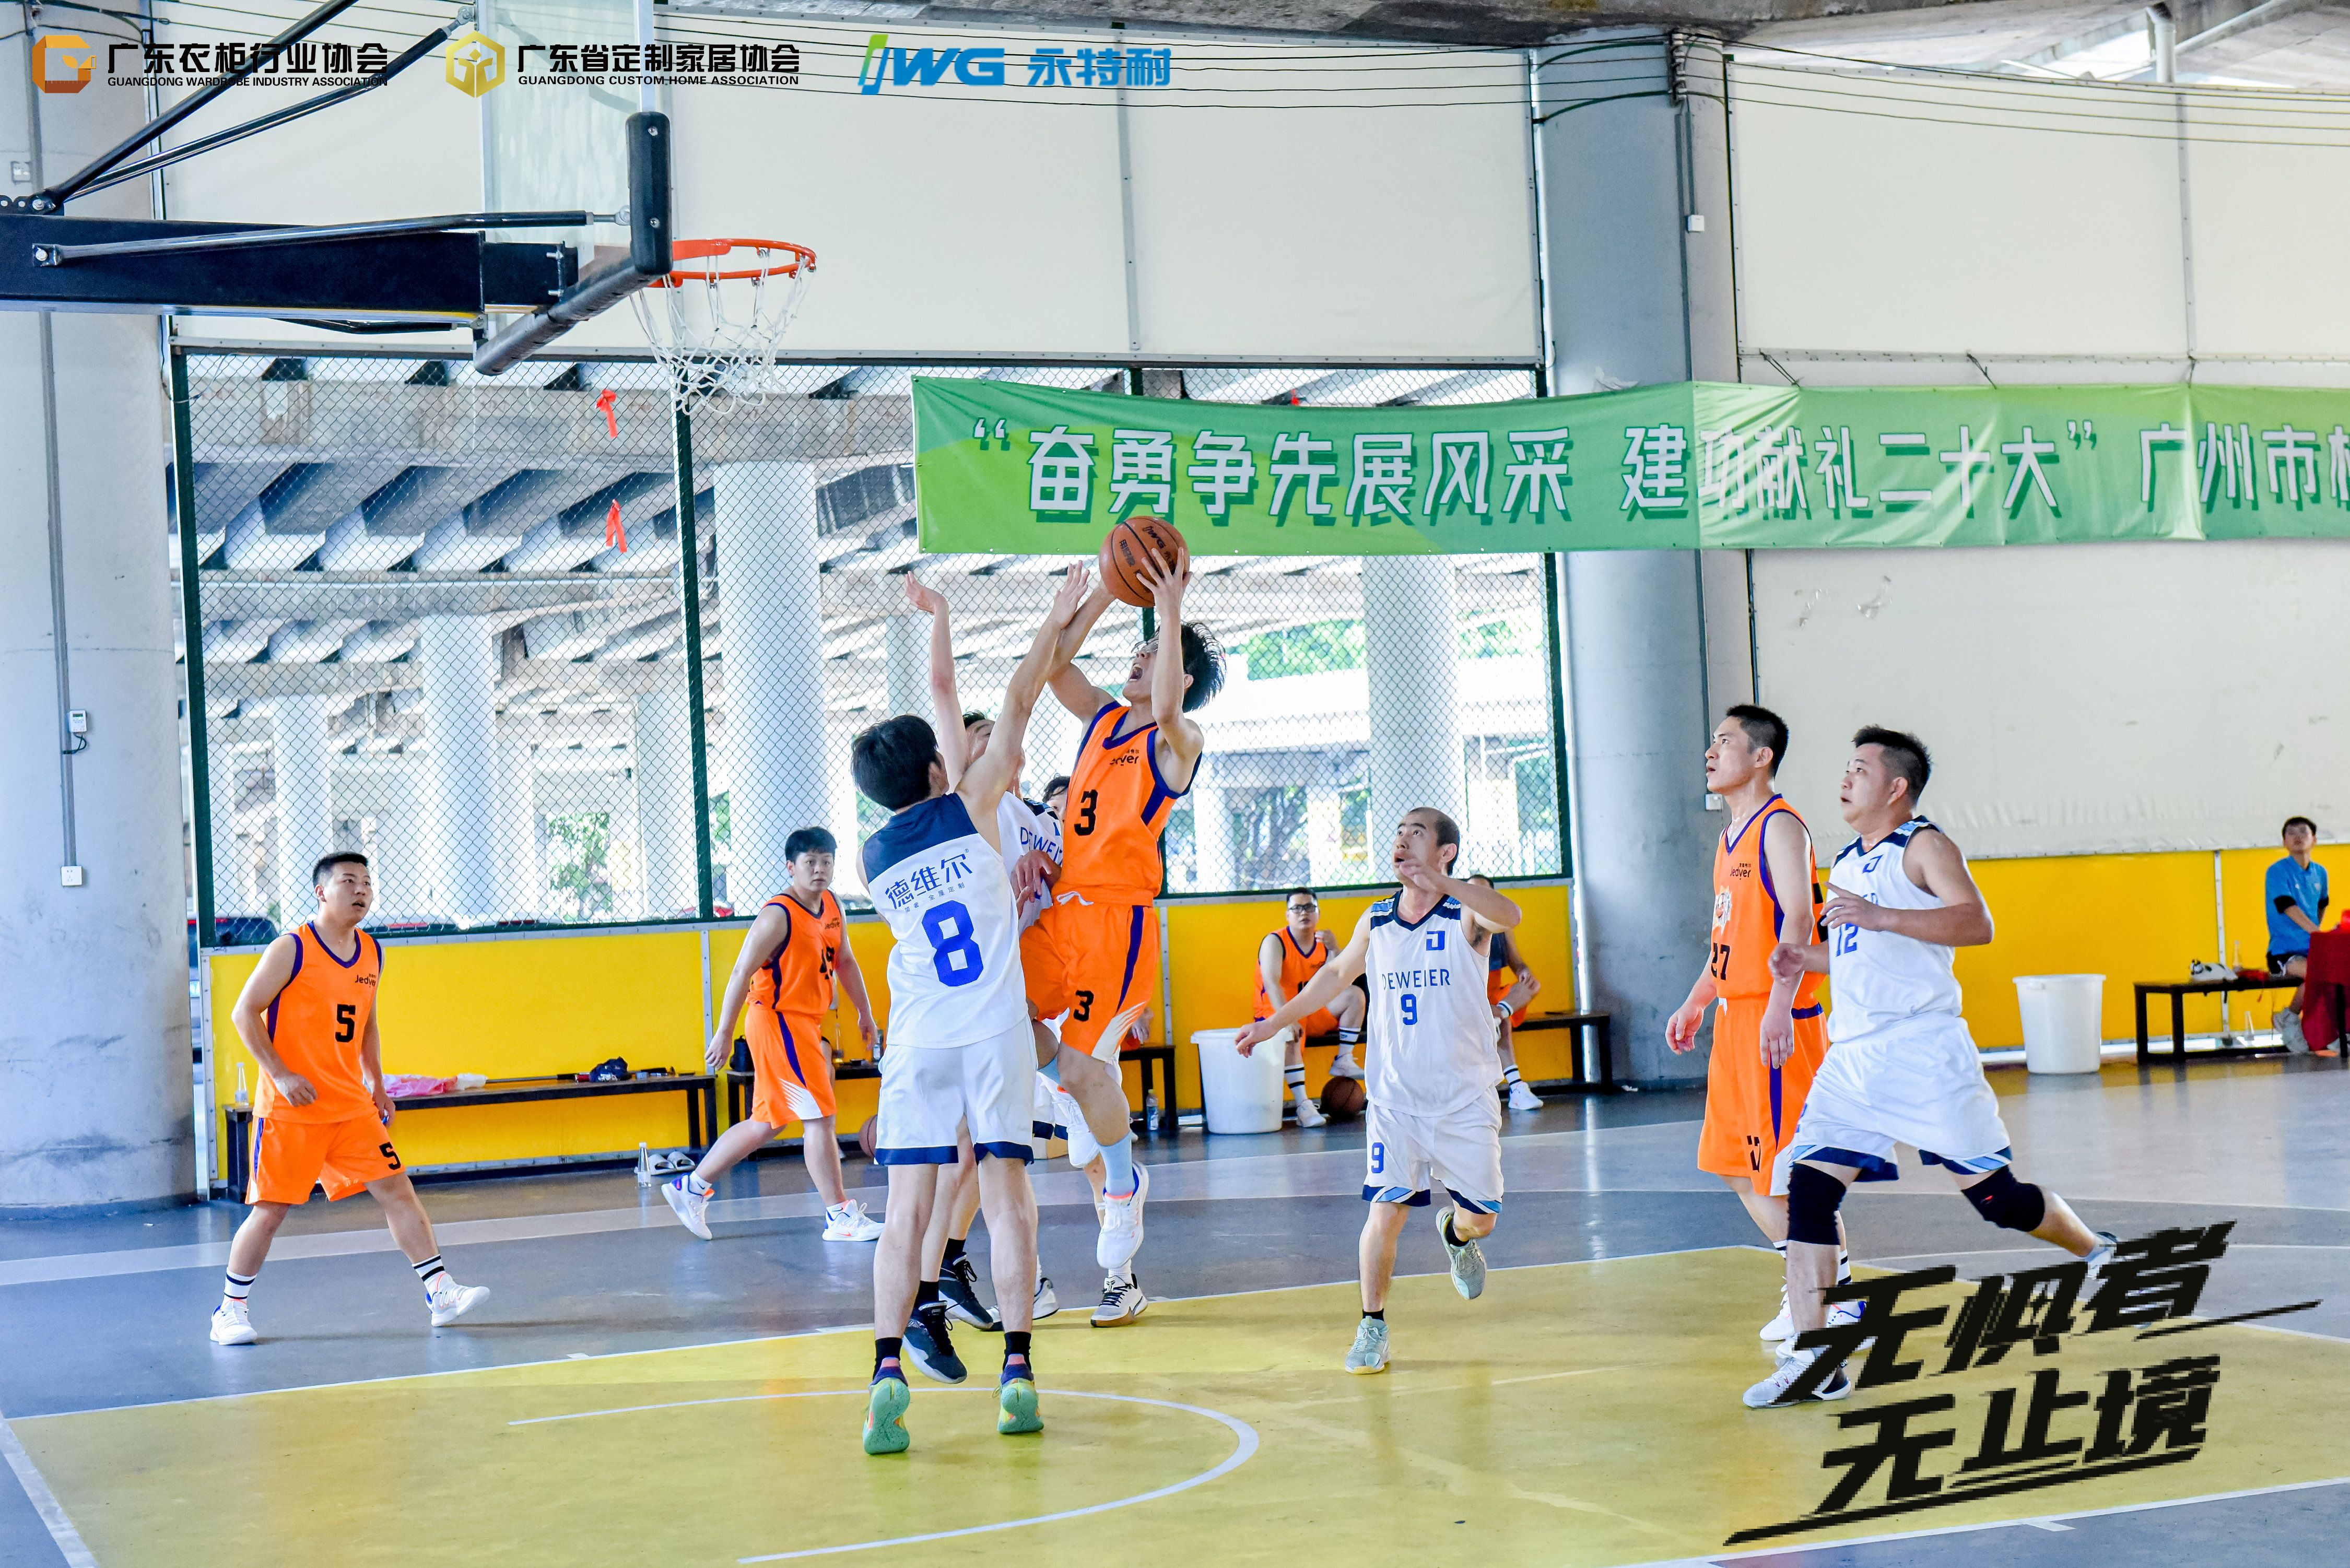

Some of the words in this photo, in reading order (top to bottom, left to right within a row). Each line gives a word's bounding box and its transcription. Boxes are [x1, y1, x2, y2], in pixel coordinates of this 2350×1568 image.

[1074, 789, 1098, 836] 3
[885, 854, 973, 910] 德维尔
[921, 900, 984, 987] 8
[1711, 942, 1730, 981] 27
[1382, 969, 1451, 991] DEWEIER
[335, 1004, 356, 1043] 5
[1073, 990, 1094, 1022] 3
[1400, 993, 1418, 1025] 9
[379, 1142, 402, 1170] 5
[1371, 1142, 1384, 1174] 9
